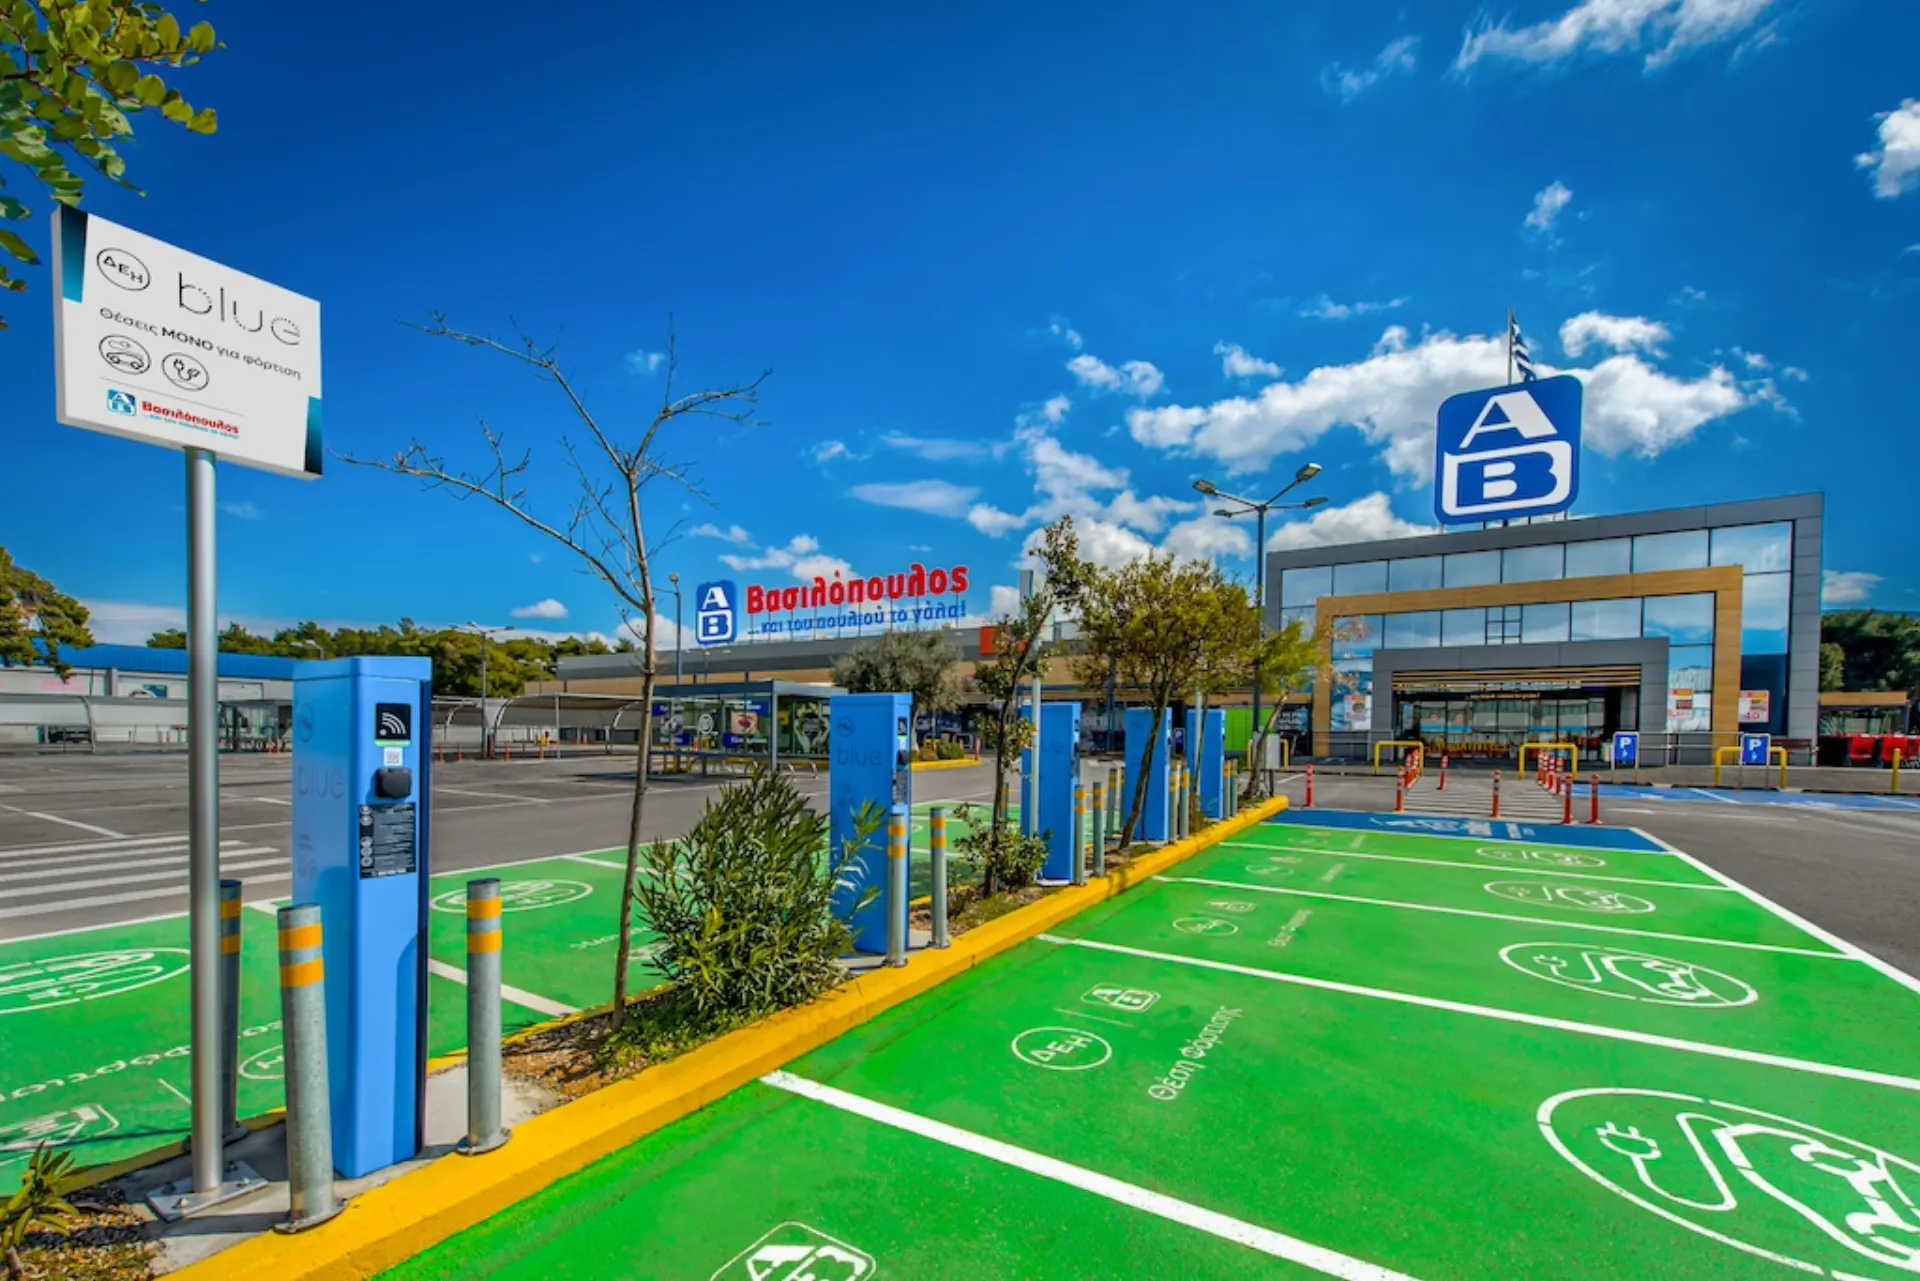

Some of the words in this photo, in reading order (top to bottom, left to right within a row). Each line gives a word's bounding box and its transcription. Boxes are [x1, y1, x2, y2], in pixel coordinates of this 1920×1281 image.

[103, 255, 143, 285] ΔΕΗ
[178, 272, 301, 346] blue
[216, 346, 240, 360] για
[746, 563, 969, 615] Βασιλόπουλος
[1748, 739, 1762, 751] P
